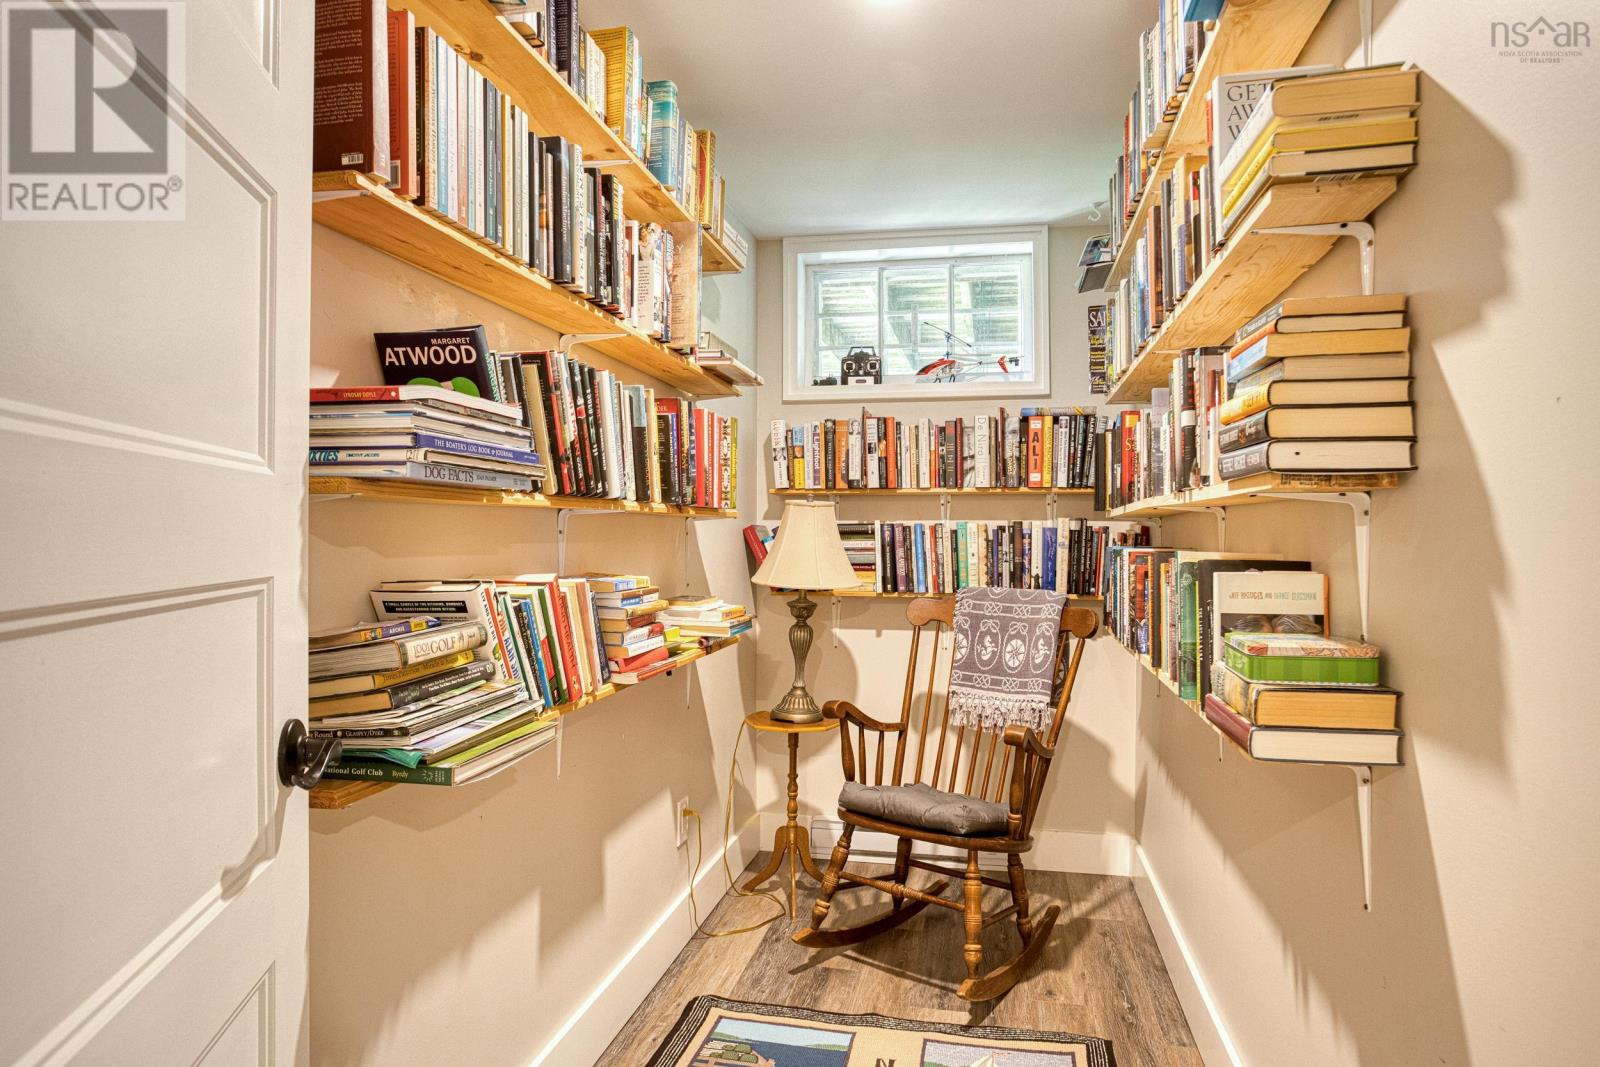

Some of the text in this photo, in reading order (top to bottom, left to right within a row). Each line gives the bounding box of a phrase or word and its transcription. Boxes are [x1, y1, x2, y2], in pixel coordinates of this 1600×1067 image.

[430, 337, 470, 345] MARGARET
[385, 345, 477, 366] ATWOOD
[434, 439, 445, 447] THE
[812, 436, 820, 469] Lightfoot
[424, 465, 445, 479] DOG
[448, 469, 474, 482] FACTS
[430, 636, 456, 653] GOLF
[351, 767, 366, 775] Golf
[367, 768, 383, 776] Club
